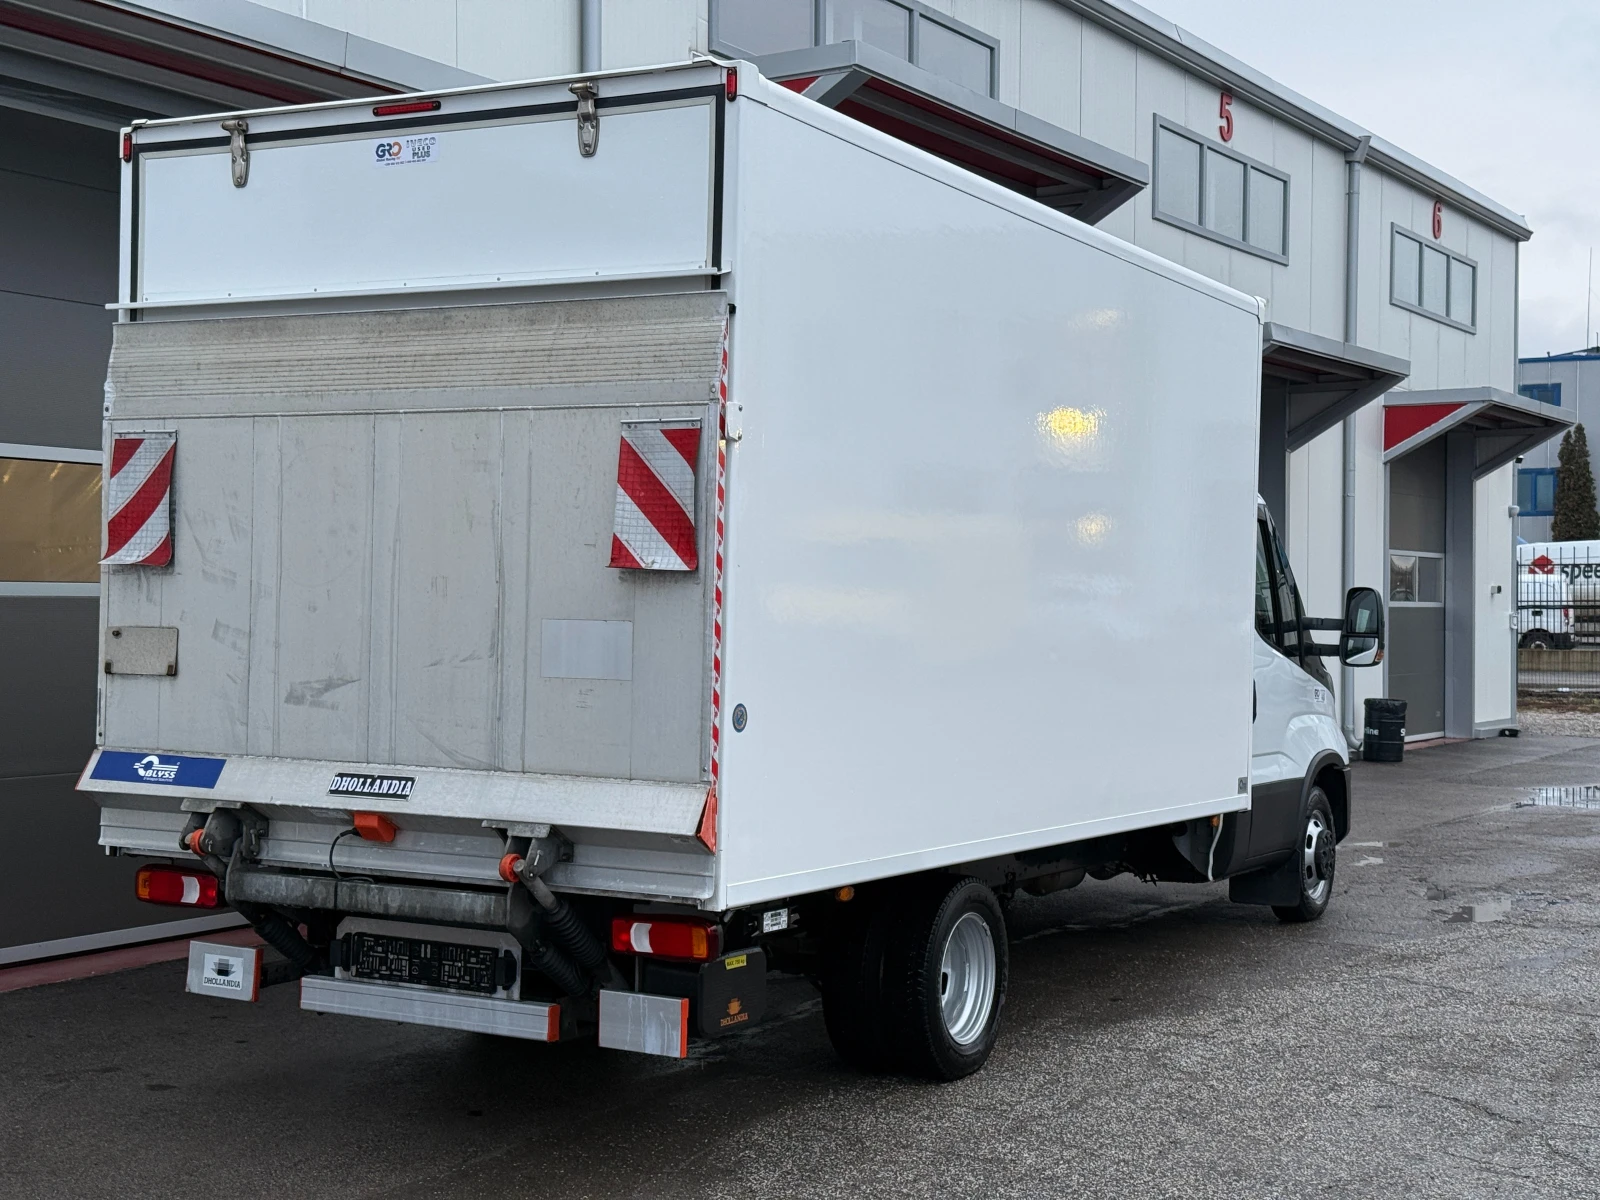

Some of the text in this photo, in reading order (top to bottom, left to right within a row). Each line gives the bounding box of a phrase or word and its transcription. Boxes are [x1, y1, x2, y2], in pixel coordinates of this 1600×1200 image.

[1219, 92, 1233, 142] 5
[406, 137, 436, 148] IVECO
[376, 142, 402, 158] GRO
[412, 151, 430, 159] PLUS
[1432, 201, 1442, 239] 6
[145, 770, 176, 779] BLYSS
[330, 776, 412, 795] DHOLLANDIA
[204, 976, 241, 988] DHOLLANDIA
[720, 1012, 749, 1026] DHOLLANDIA
